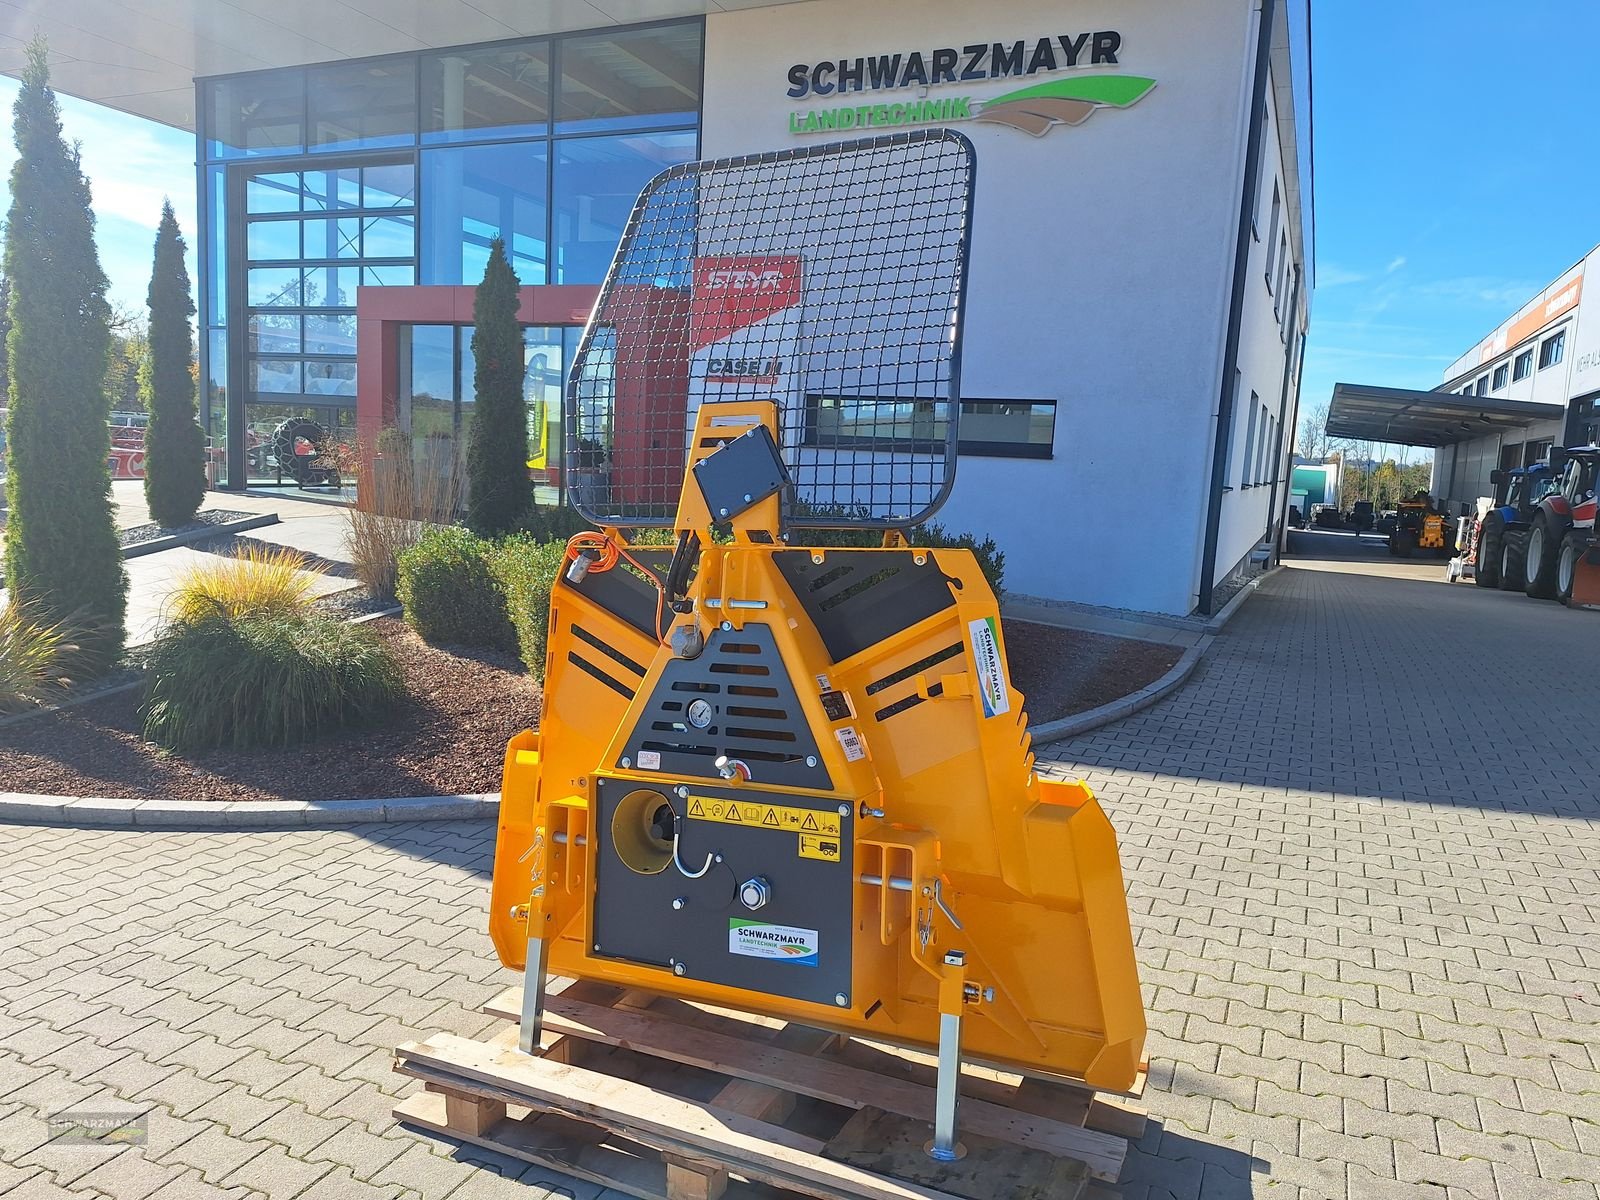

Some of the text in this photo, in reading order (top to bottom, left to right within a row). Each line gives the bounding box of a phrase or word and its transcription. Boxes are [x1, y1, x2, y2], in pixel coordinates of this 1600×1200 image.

[786, 30, 1122, 98] SCHWARZMAYR
[789, 96, 972, 133] LANDTECHNIK
[708, 360, 760, 375] CASE
[984, 627, 1001, 700] SCHWARZMAYR
[738, 928, 805, 945] SCHWARZMAYR
[739, 938, 778, 948] LANDTECHNIK
